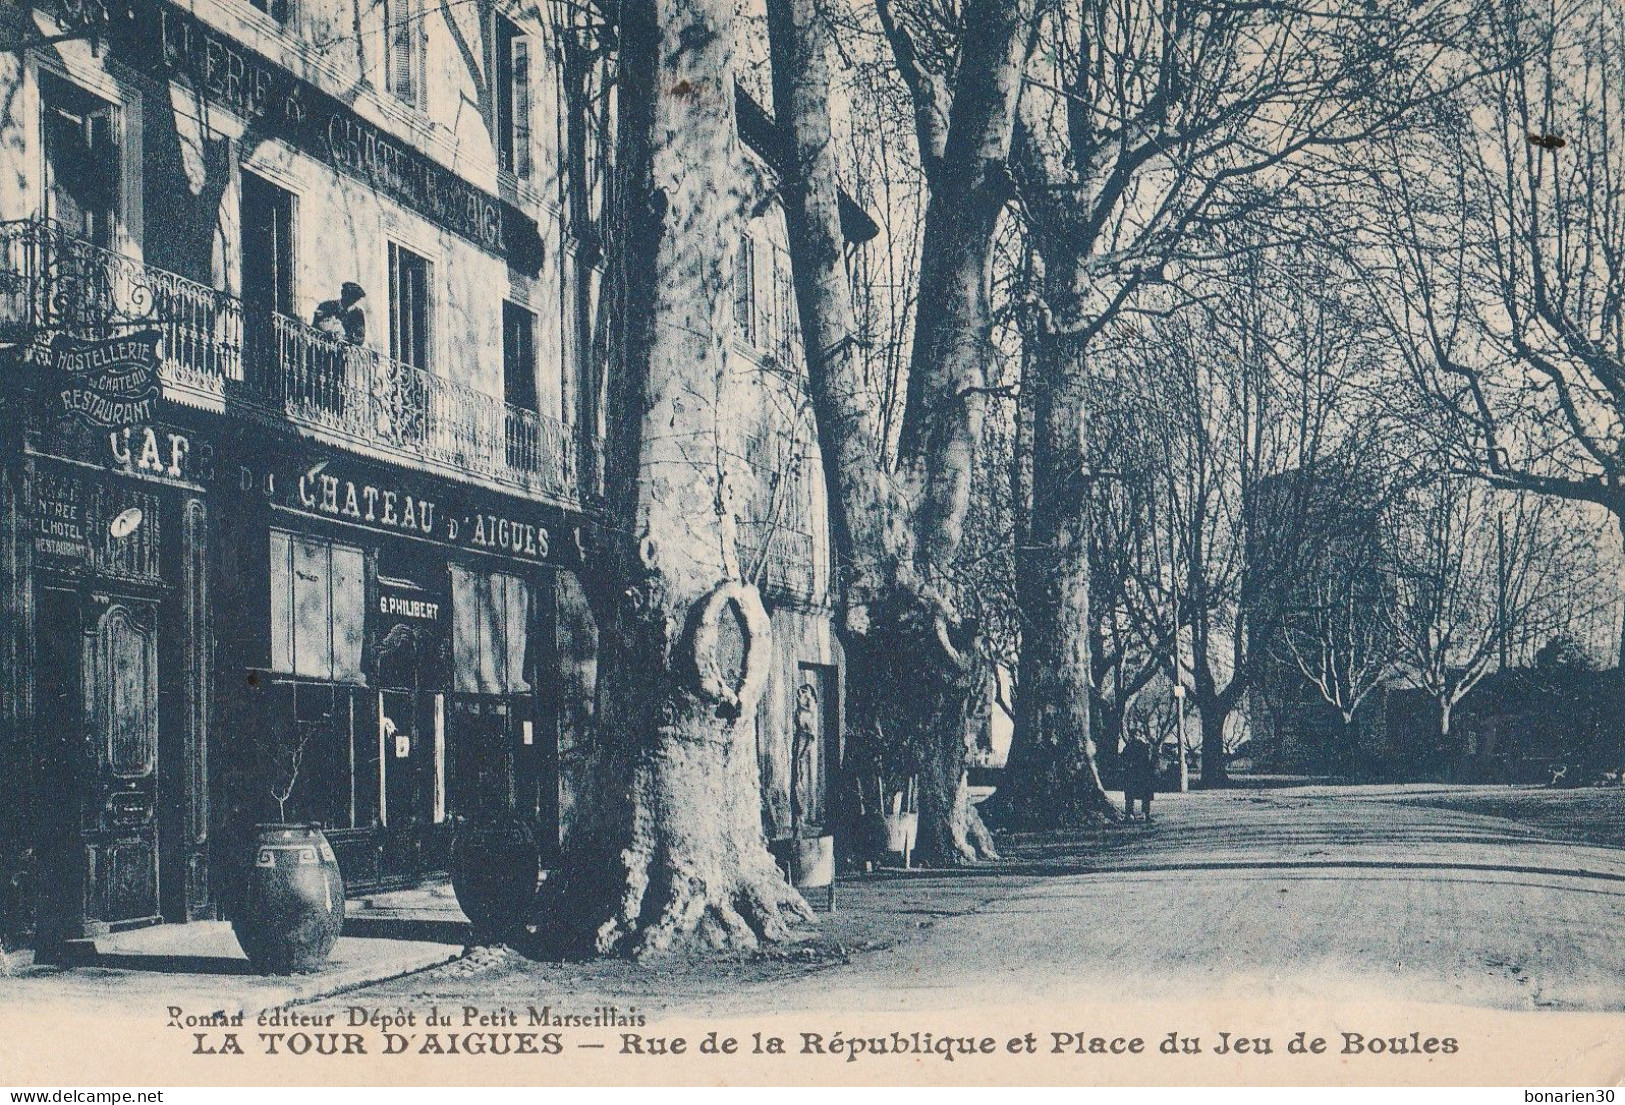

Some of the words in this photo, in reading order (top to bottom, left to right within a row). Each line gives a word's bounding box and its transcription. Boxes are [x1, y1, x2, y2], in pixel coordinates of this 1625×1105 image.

[57, 341, 150, 372] HOSTELLERIE
[98, 369, 147, 392] CHATEAU
[60, 388, 151, 425] RESTAURANT
[299, 466, 435, 533] CHATEAU
[448, 512, 549, 558] D'AIGUES
